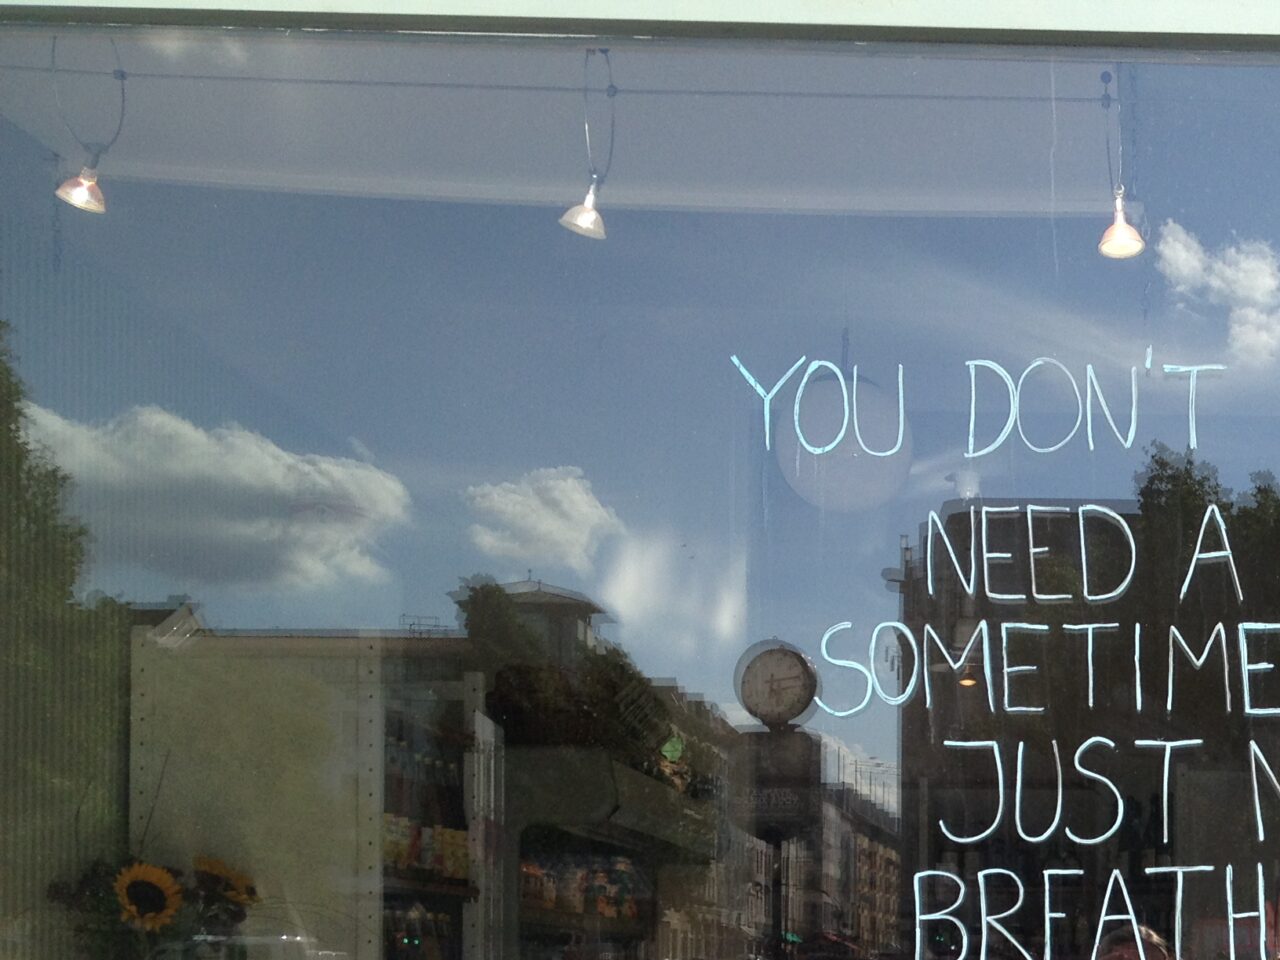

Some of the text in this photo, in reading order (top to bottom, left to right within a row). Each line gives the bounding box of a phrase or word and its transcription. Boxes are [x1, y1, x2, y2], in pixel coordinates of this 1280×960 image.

[730, 355, 904, 457] YOU
[964, 345, 1228, 458] DON'T
[926, 504, 1136, 602] NEED
[1179, 504, 1244, 602] A
[939, 736, 1204, 845] JUST
